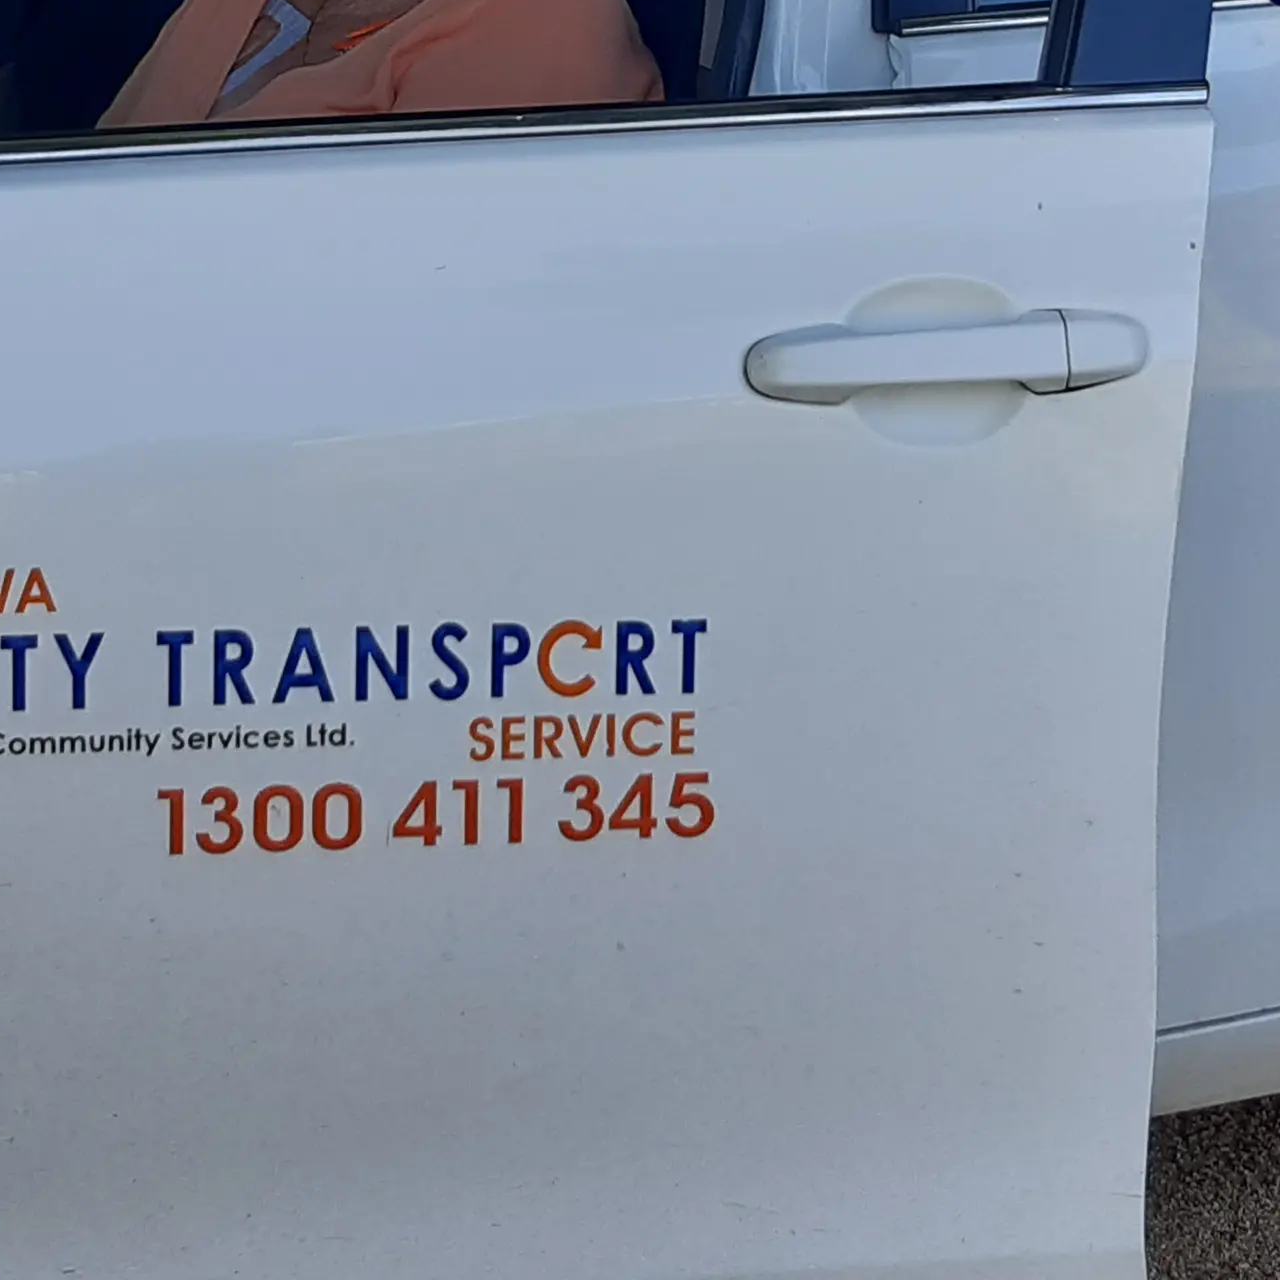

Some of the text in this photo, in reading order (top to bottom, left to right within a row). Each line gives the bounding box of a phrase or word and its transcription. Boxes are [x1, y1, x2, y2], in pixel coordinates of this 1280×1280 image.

[156, 618, 707, 706] TRANSPORT
[171, 725, 295, 751] Services
[306, 722, 356, 748] Ltd.
[468, 710, 696, 761] SERVICE
[157, 771, 716, 856] 1300 411 345
